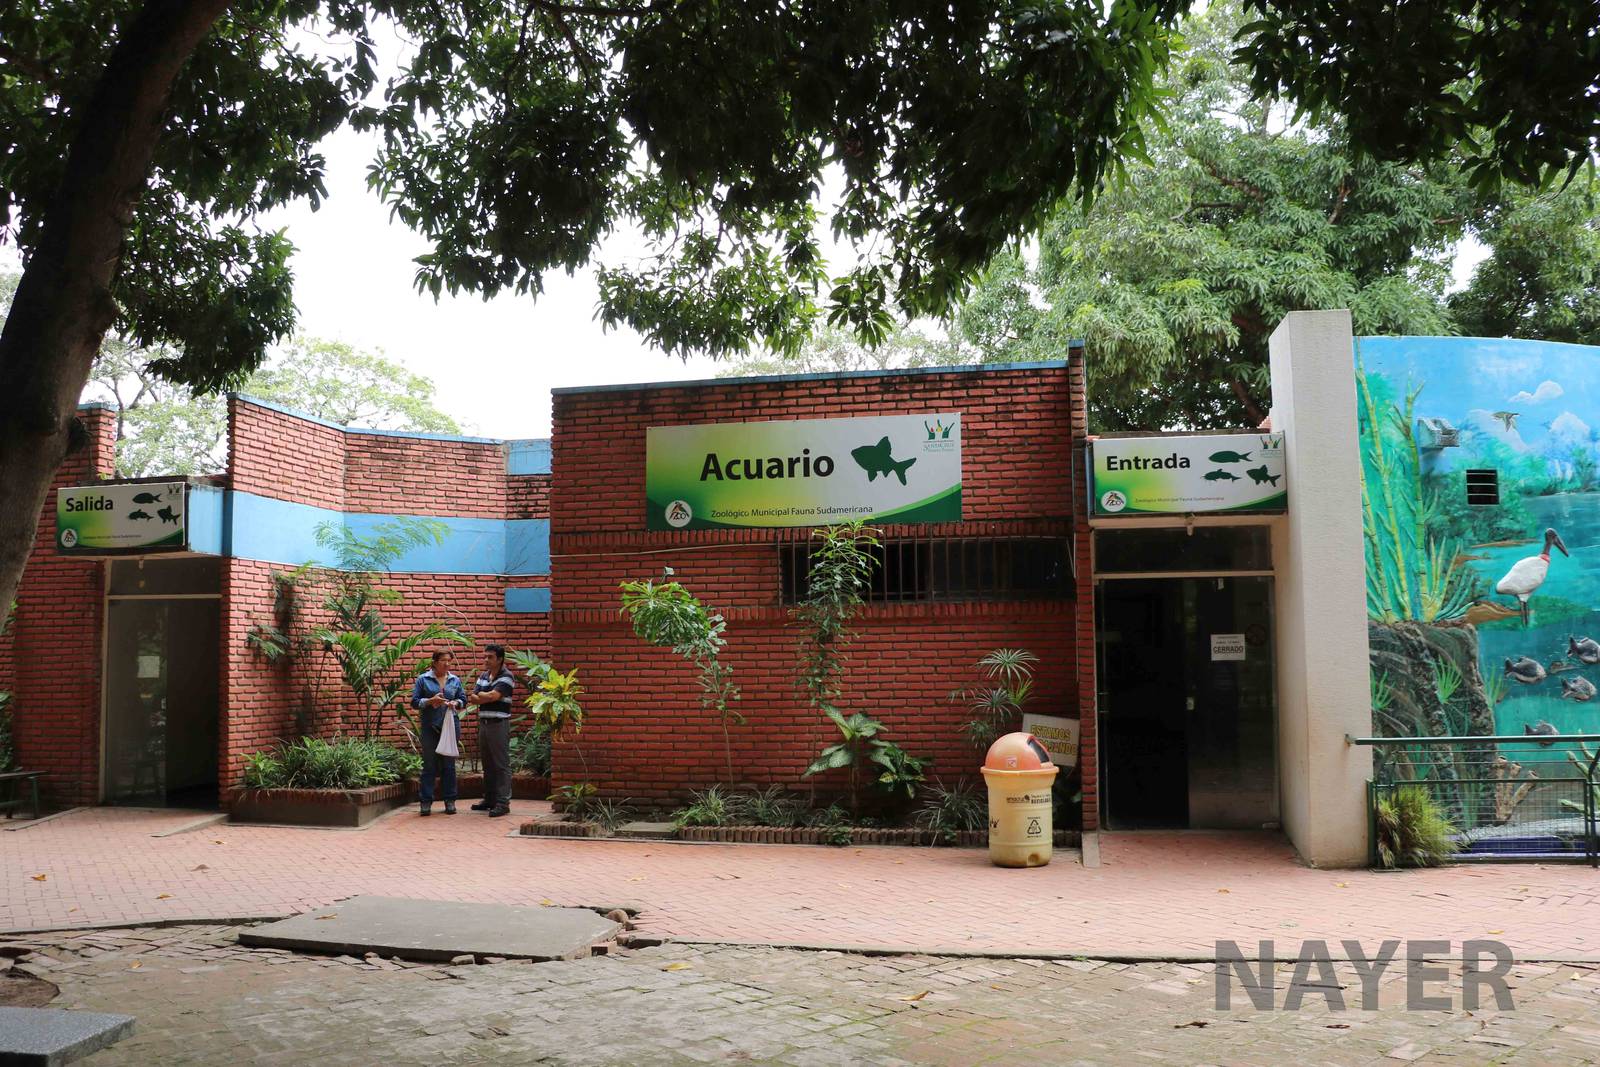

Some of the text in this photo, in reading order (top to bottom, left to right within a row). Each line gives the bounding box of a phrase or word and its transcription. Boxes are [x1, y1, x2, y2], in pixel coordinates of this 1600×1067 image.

[700, 449, 834, 482] Acuario
[1106, 453, 1191, 471] Entrada
[66, 496, 114, 512] Salida
[751, 508, 789, 516] Municipal
[791, 507, 815, 515] Fauna
[816, 505, 873, 515] Sudamericana
[1213, 646, 1243, 654] CERRADO
